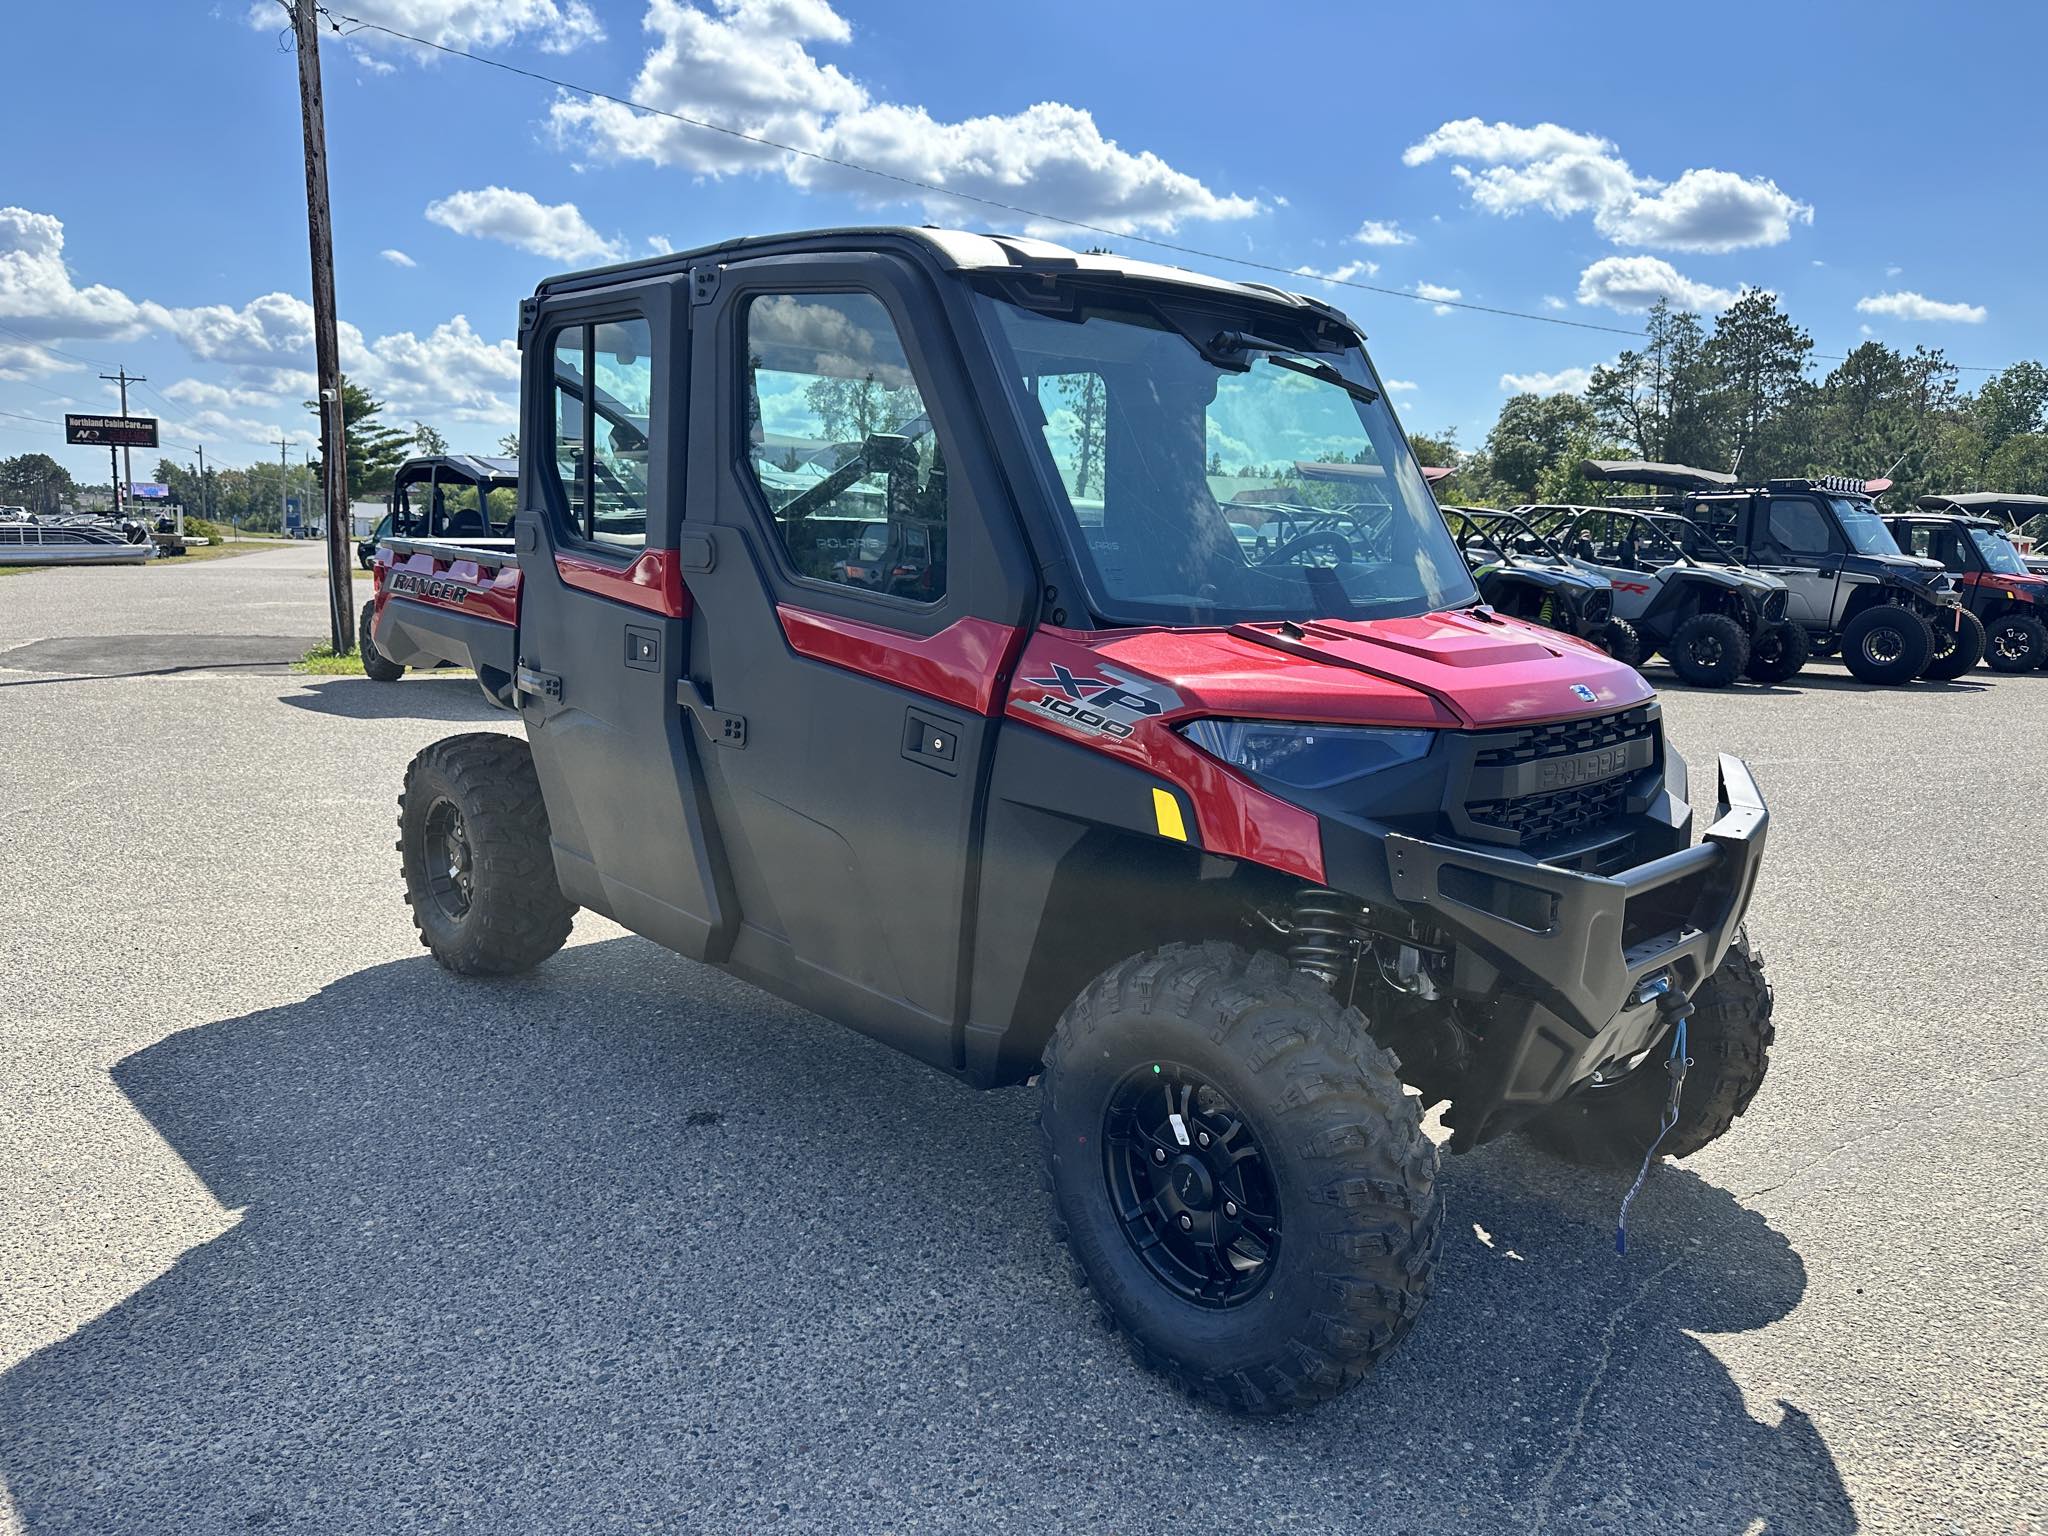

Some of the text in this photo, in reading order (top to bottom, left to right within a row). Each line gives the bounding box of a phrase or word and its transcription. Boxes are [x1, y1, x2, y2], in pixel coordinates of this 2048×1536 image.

[69, 418, 103, 428] Northland
[104, 419, 124, 429] Cabin
[816, 538, 880, 549] POLARIS
[392, 573, 468, 605] RANGER
[1021, 661, 1164, 717] XP
[1035, 708, 1123, 744] DUAL OVERHEAD CAM
[1039, 694, 1135, 740] 1000
[1543, 748, 1626, 788] POLARIS
